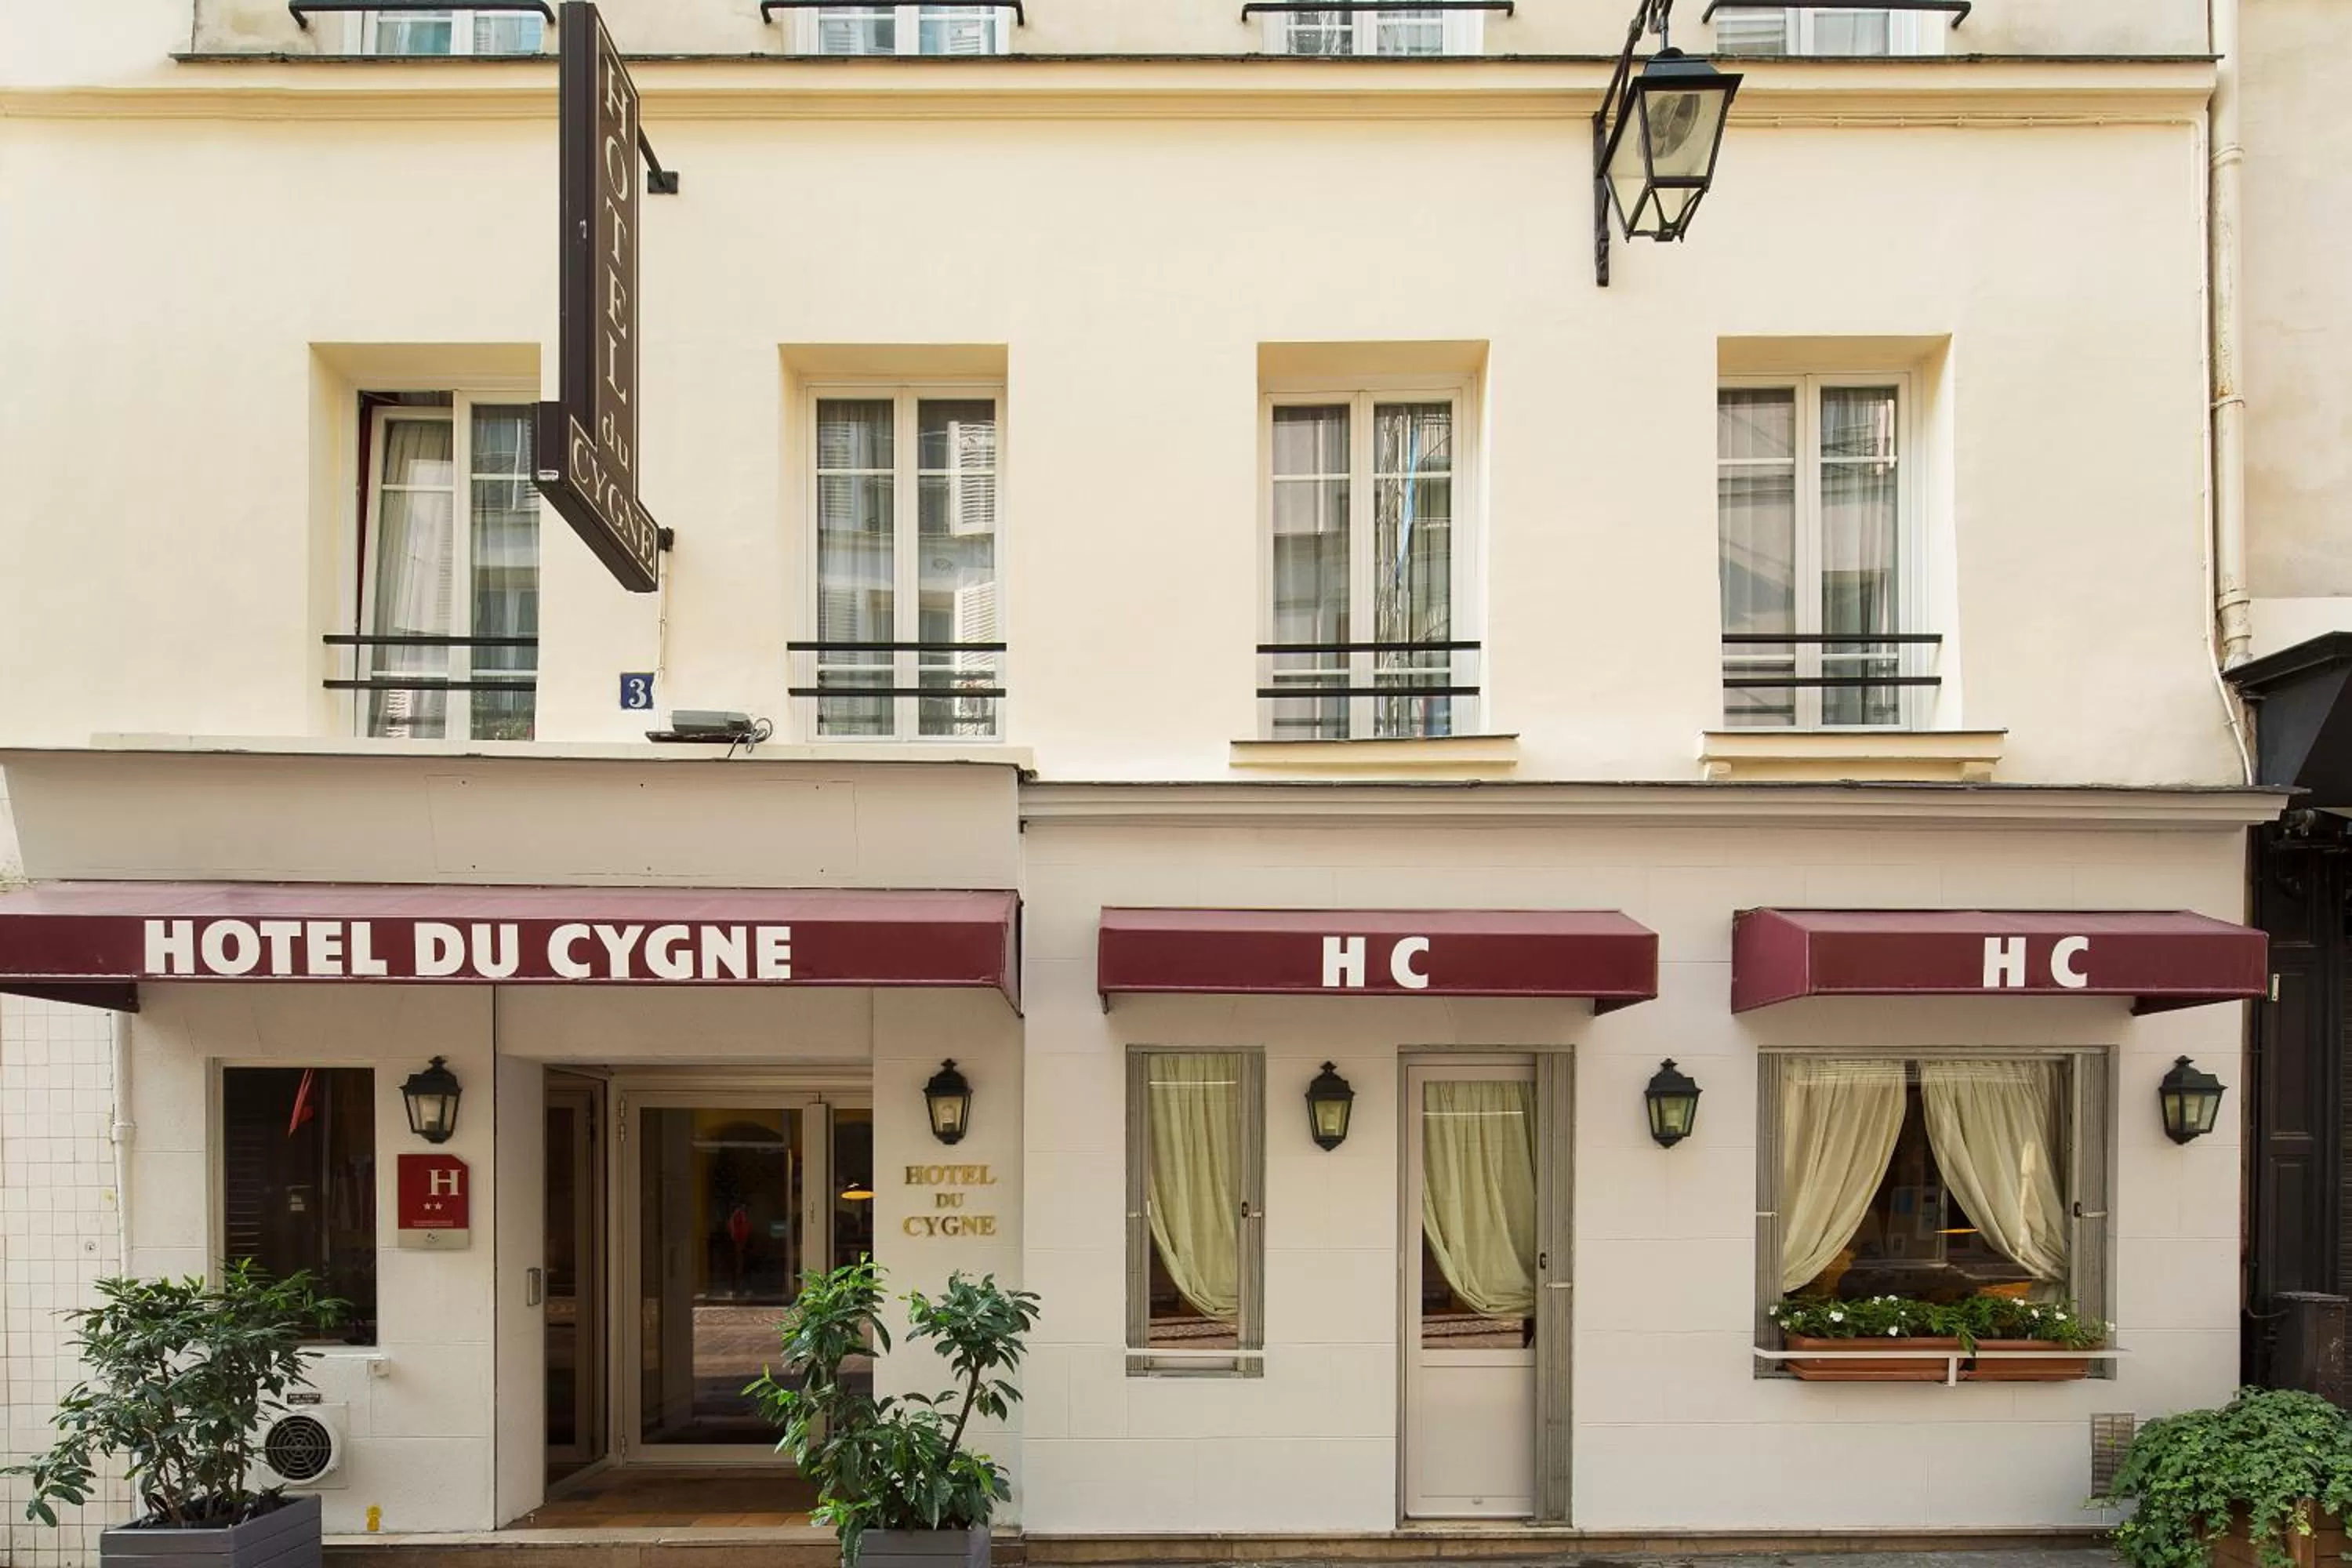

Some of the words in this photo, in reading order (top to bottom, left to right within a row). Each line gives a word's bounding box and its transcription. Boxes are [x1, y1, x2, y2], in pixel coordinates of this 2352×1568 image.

[604, 53, 630, 406] HOTEL
[602, 411, 630, 473] du
[572, 437, 654, 569] CYGNE
[628, 678, 648, 708] 3
[144, 920, 387, 976] HOTEL
[414, 922, 520, 979] DU
[546, 924, 791, 982] CYGNE
[426, 1169, 462, 1196] H
[904, 1165, 997, 1185] HOTEL
[935, 1192, 965, 1208] DU
[902, 1216, 996, 1236] CYGNE
